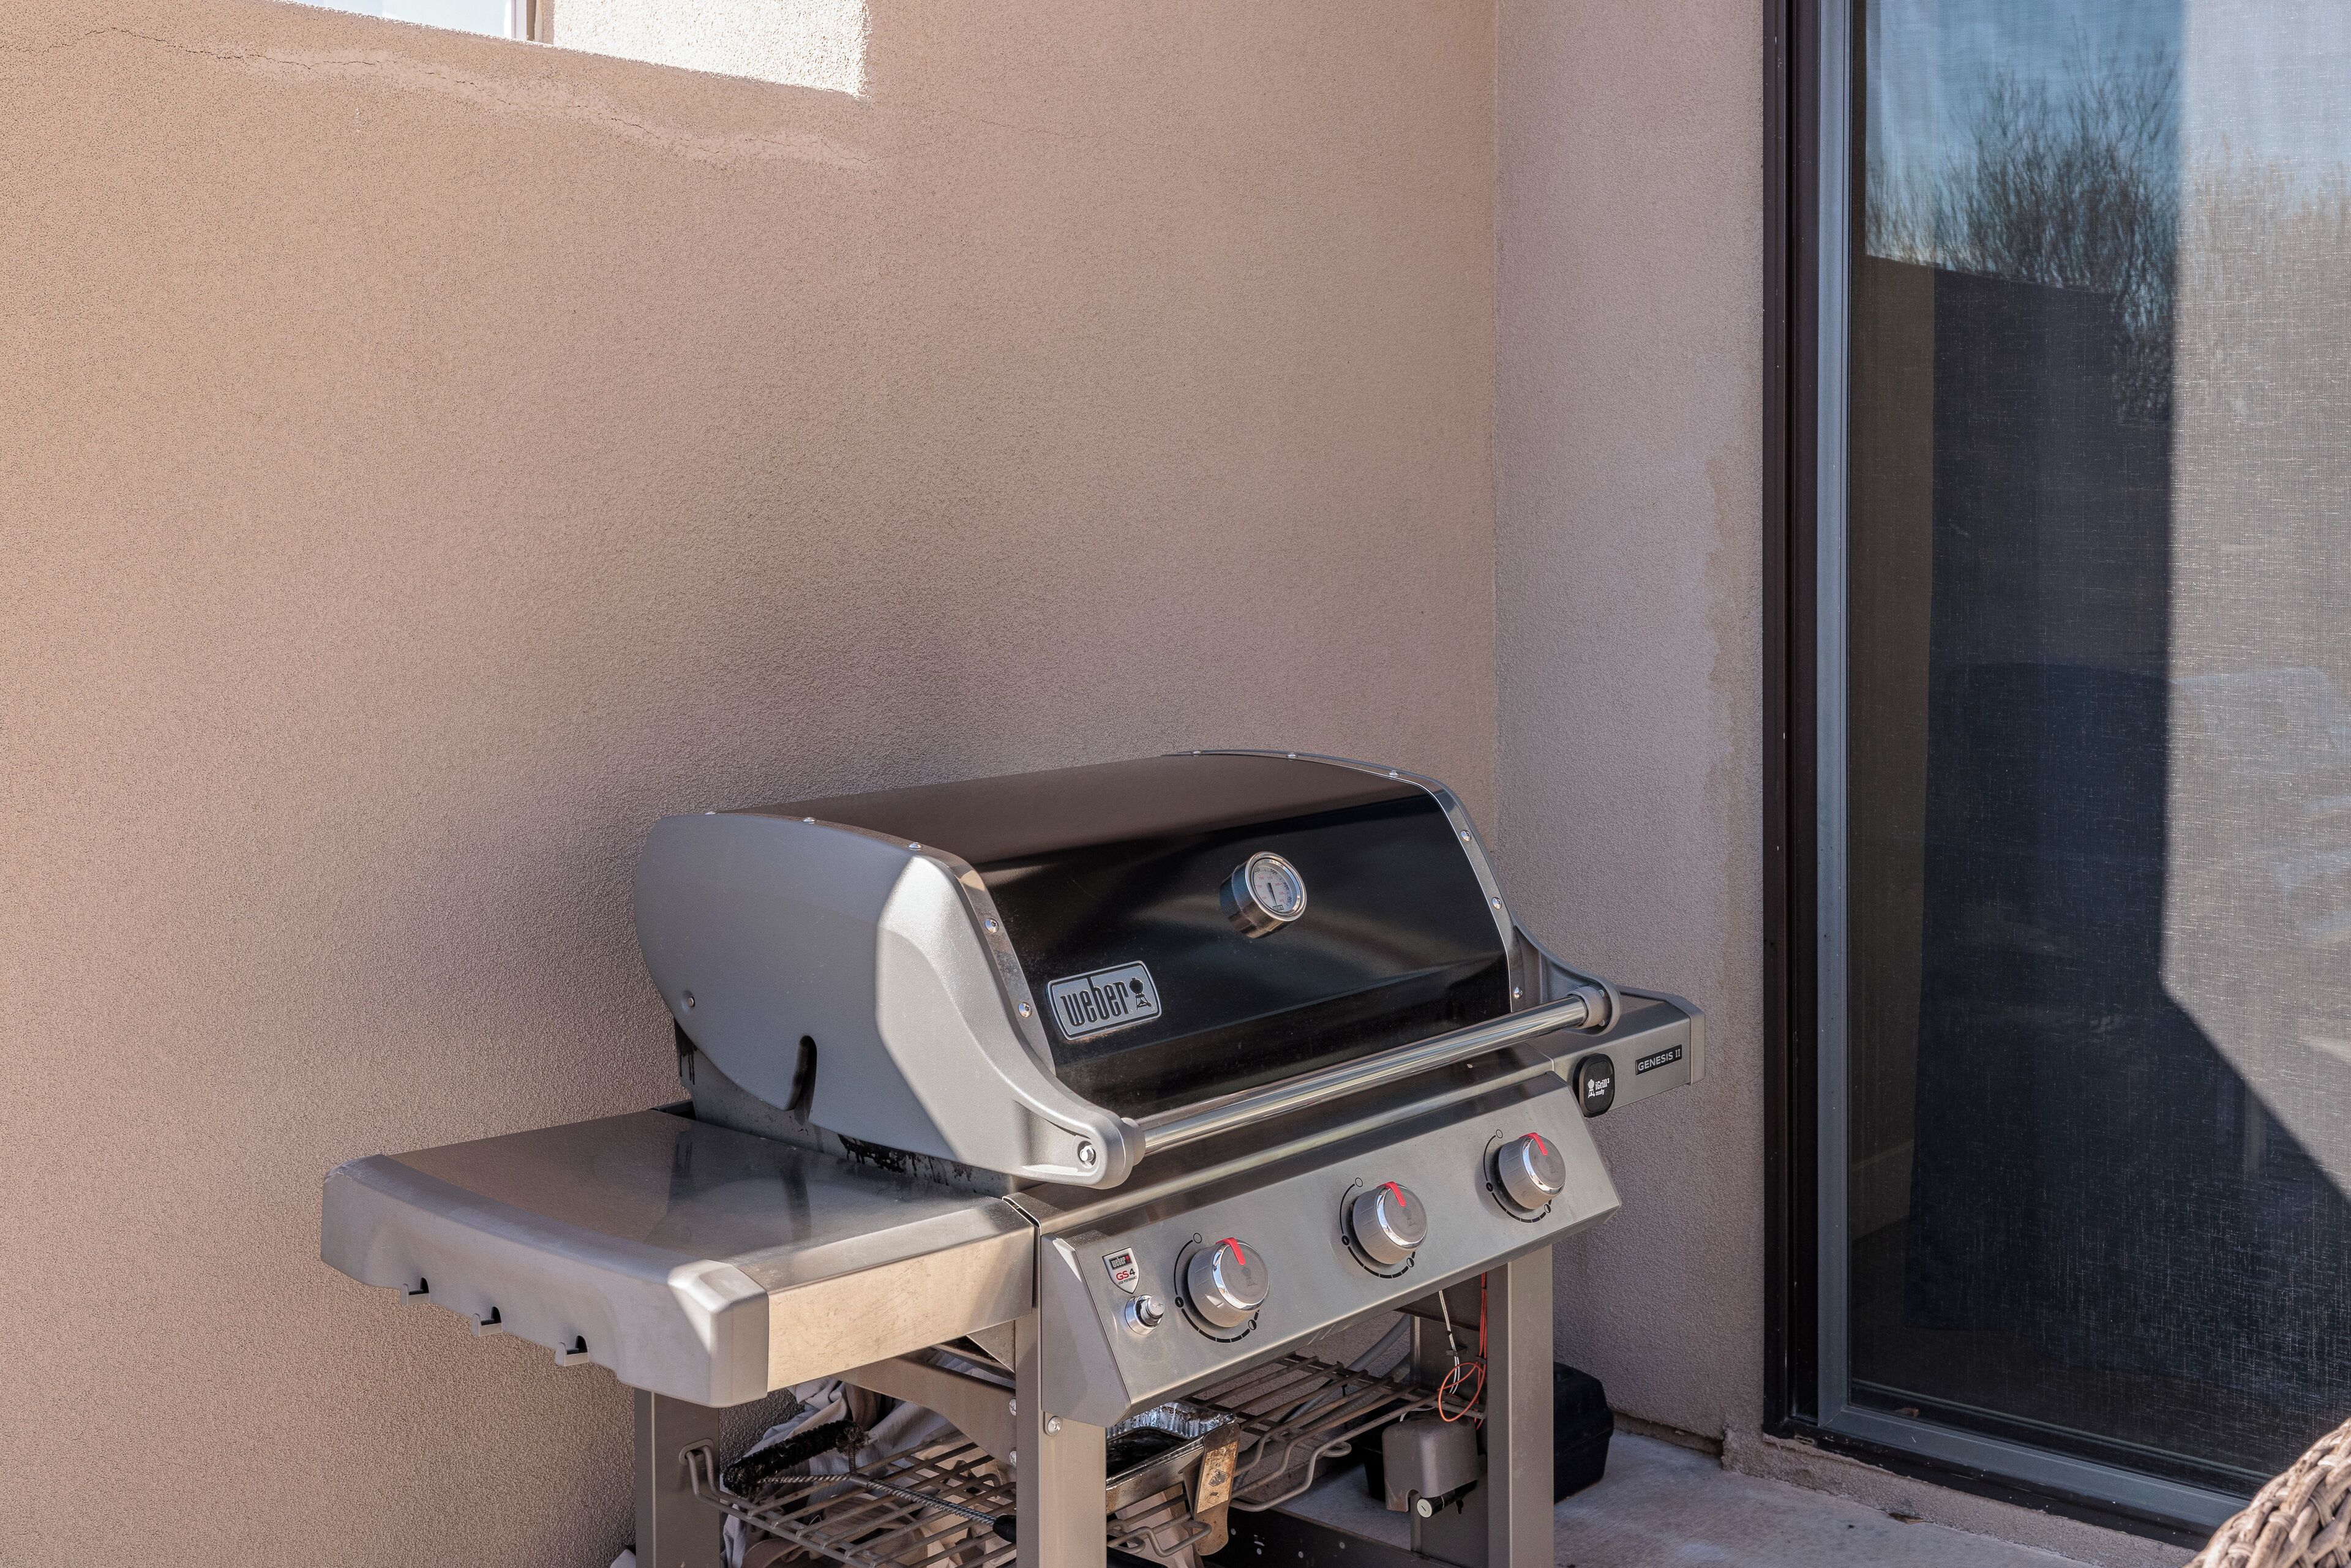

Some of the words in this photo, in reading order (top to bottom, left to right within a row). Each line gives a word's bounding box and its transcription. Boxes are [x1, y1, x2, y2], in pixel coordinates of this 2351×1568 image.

[1060, 977, 1129, 1027] weber
[1638, 1051, 1673, 1071] GENESIS
[1675, 1049, 1681, 1057] II
[1111, 1256, 1126, 1267] weber
